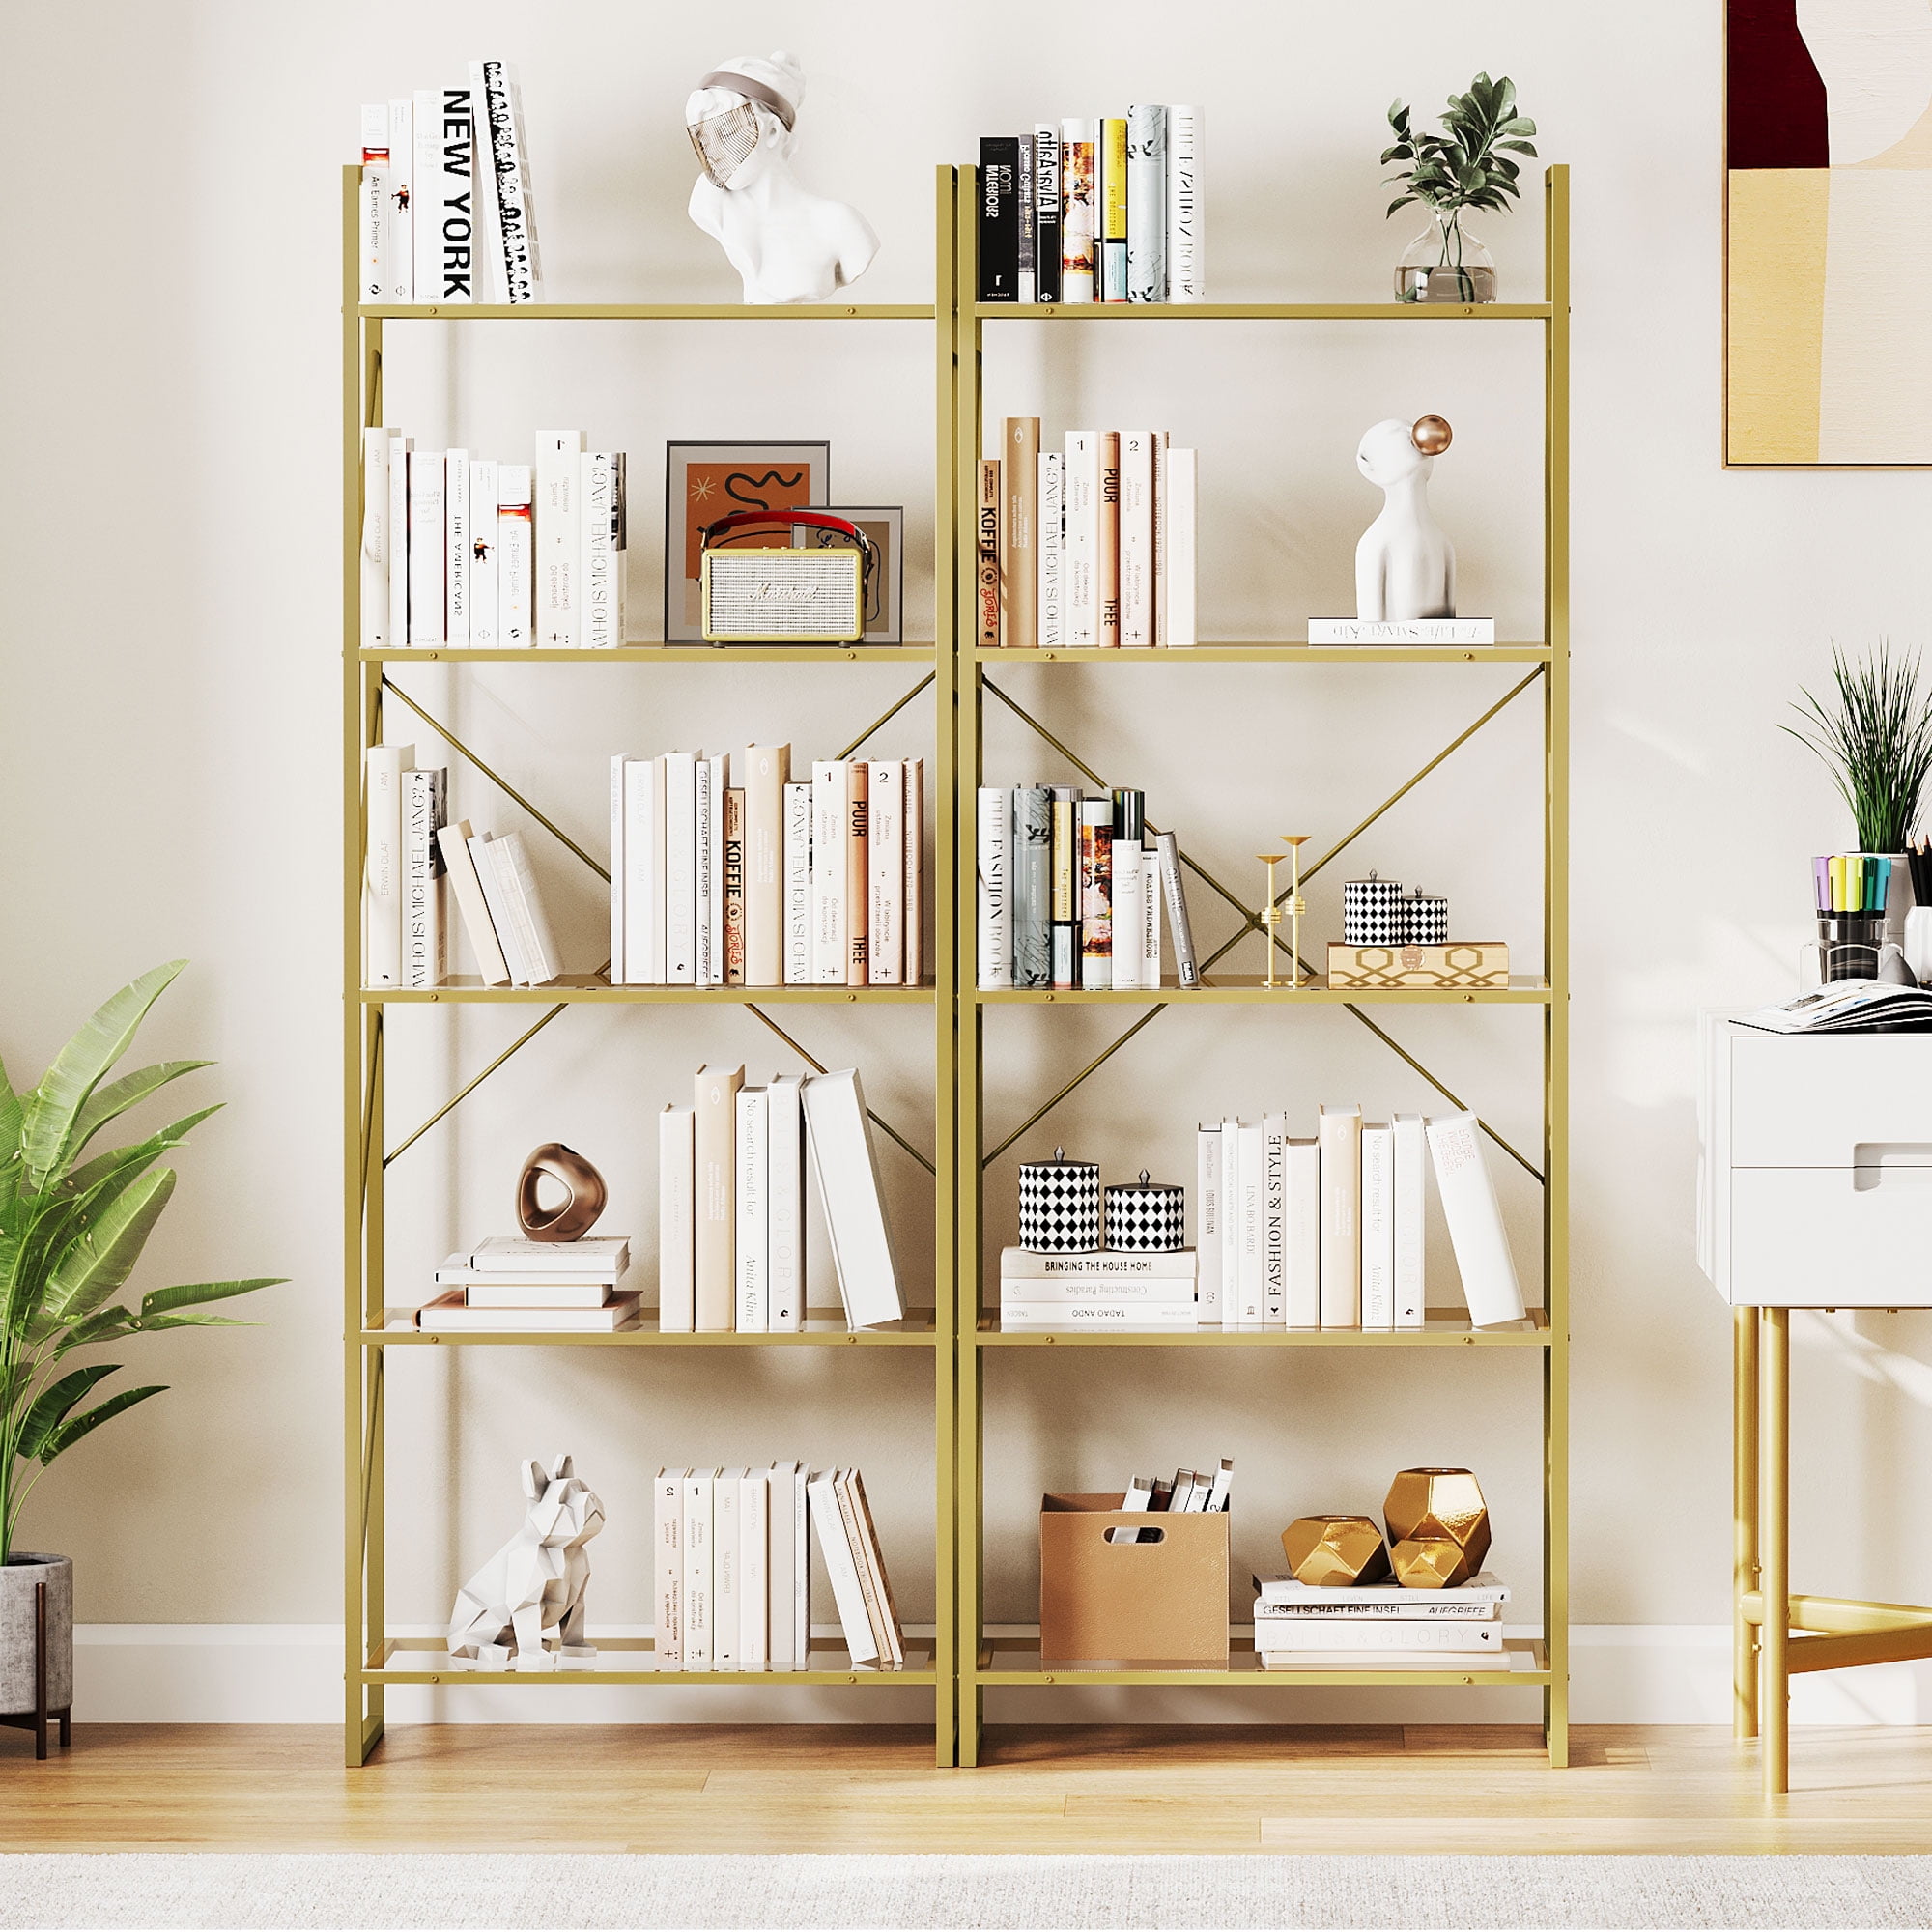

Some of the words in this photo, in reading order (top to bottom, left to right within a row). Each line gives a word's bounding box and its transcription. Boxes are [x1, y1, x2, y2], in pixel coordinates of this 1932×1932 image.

[443, 90, 471, 178] NEW
[371, 176, 380, 188] An
[371, 189, 380, 219] Eames
[443, 191, 471, 298] YORK
[1129, 440, 1139, 452] 2
[591, 467, 607, 516] JANG?
[1046, 467, 1059, 514] JANG?
[1104, 468, 1118, 503] PUUR
[981, 507, 997, 564] KOFFIE
[1046, 517, 1059, 583] MICHAEL
[591, 517, 607, 587] MICHAEL
[591, 589, 607, 604] IS
[1046, 587, 1059, 602] IS
[1046, 604, 1059, 644] WHO
[1104, 598, 1118, 626] THEE
[591, 608, 607, 648] WHO
[879, 772, 889, 783] 2
[412, 787, 425, 841] JANG?
[852, 800, 867, 837] PUUR
[412, 842, 425, 920] MICHAEL
[726, 840, 741, 899] KOFFIE
[988, 839, 1003, 920] FASHION
[412, 923, 425, 938] IS
[793, 924, 805, 938] IS
[852, 935, 867, 964] THEE
[412, 942, 425, 988] WHO
[746, 1098, 757, 1116] No
[746, 1118, 757, 1159] search
[1372, 1134, 1382, 1150] No
[1268, 1136, 1281, 1192] STYLE
[1372, 1151, 1382, 1185] search
[746, 1162, 757, 1197] result
[746, 1199, 757, 1215] for
[1246, 1184, 1255, 1206] LINA
[1268, 1197, 1281, 1210] &
[1372, 1187, 1382, 1214] result
[1246, 1209, 1255, 1223] BO
[1372, 1217, 1382, 1232] for
[1246, 1224, 1255, 1254] BARDI
[1044, 1261, 1083, 1272] BRINGING
[1086, 1261, 1100, 1272] THE
[1102, 1261, 1127, 1272] HOUSE
[1130, 1261, 1152, 1272] HOME
[1268, 1216, 1281, 1296] FASHION
[745, 1254, 757, 1289] Anita
[1370, 1264, 1382, 1291] Anita
[1099, 1283, 1148, 1295] Constructing
[745, 1292, 757, 1323] Klinz
[1370, 1293, 1382, 1321] Klinz
